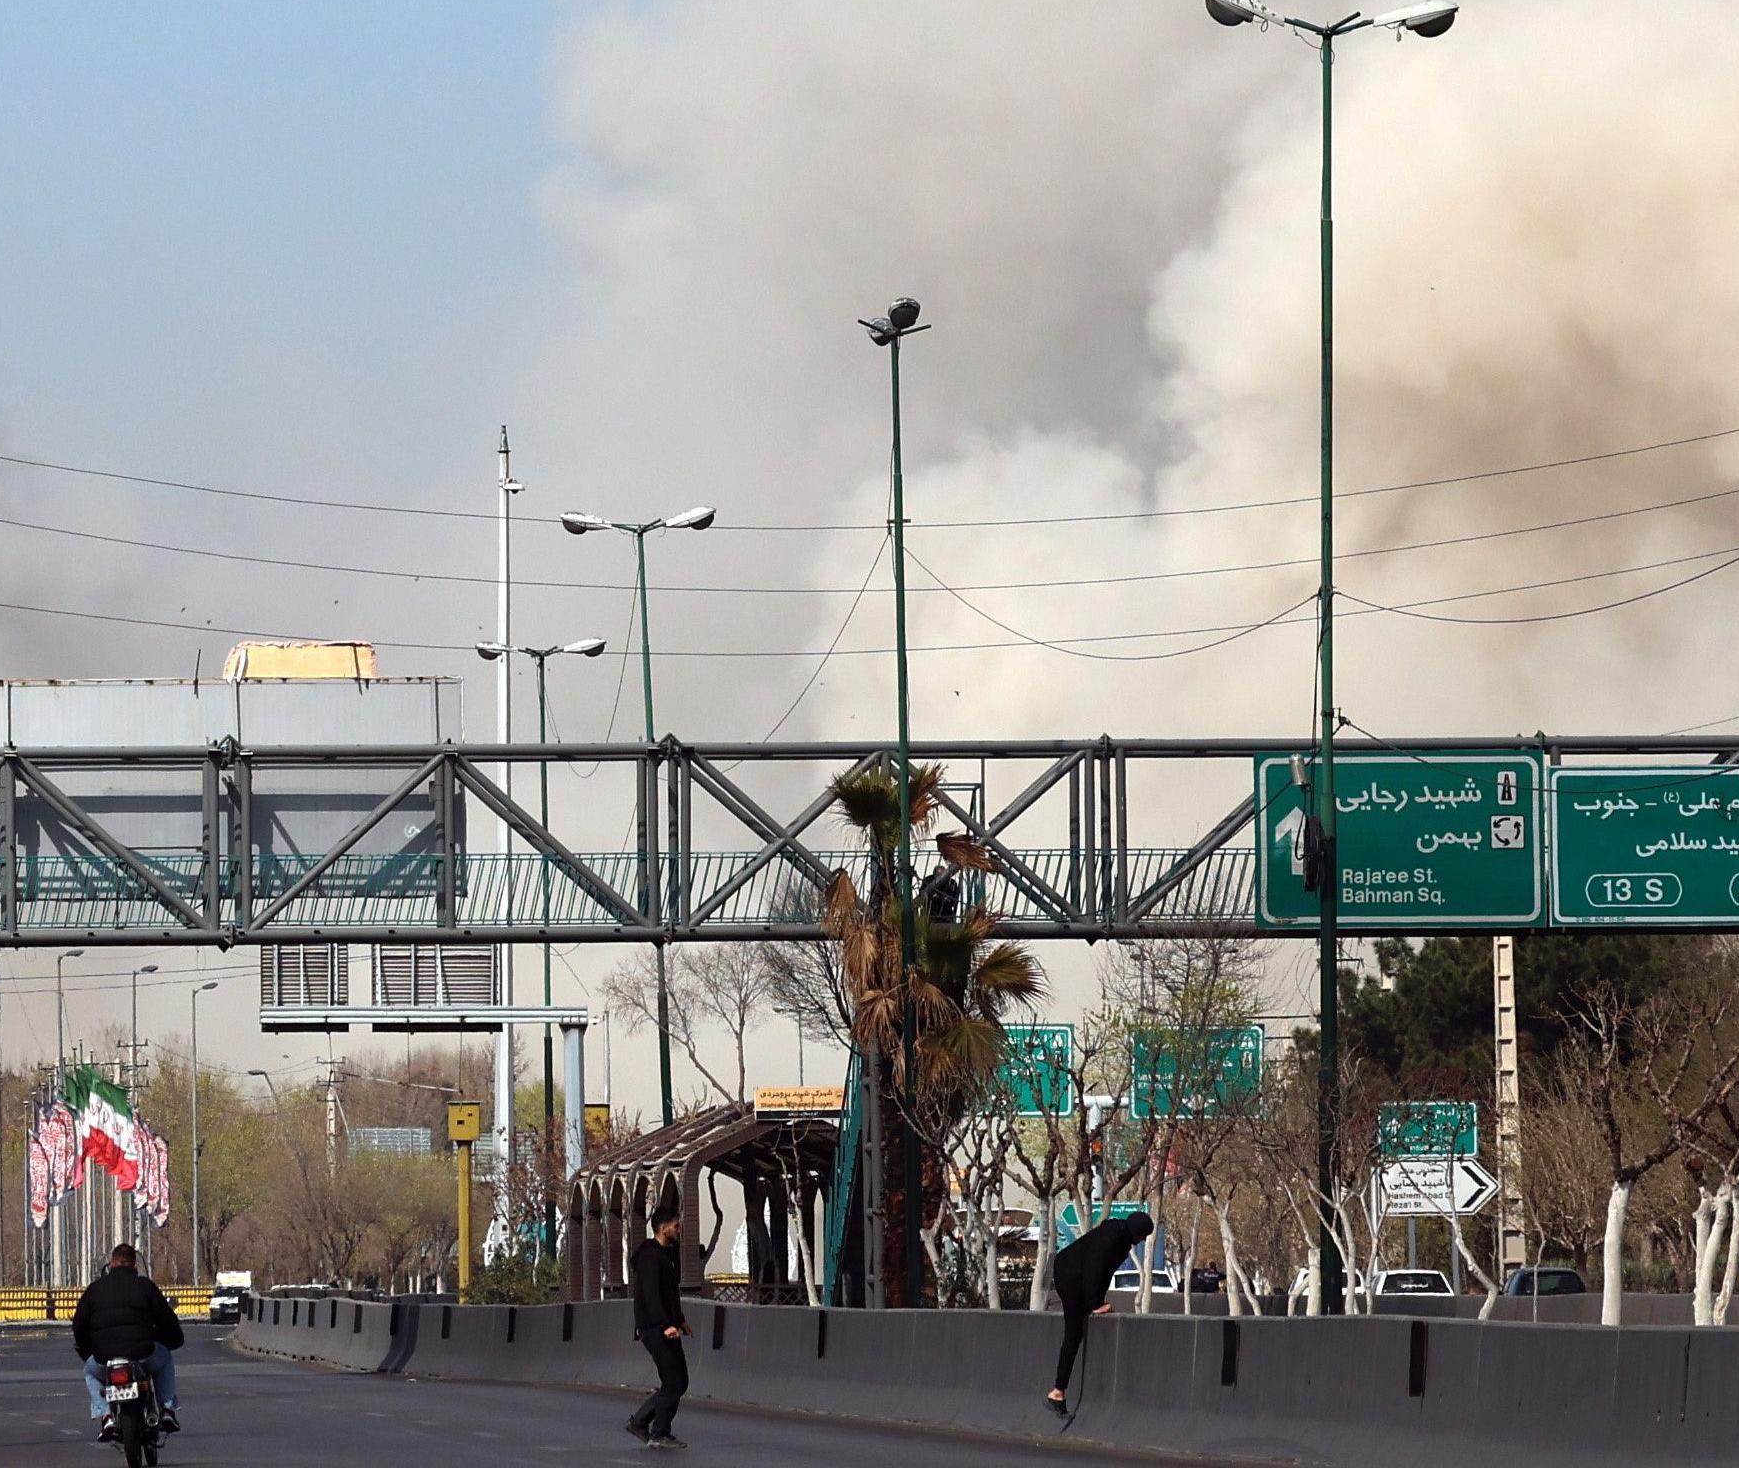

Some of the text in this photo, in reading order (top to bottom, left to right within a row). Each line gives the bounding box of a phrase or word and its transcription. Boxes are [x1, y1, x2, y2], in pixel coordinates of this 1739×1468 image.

[1335, 777, 1482, 813] شهید رجایی
[1573, 793, 1639, 820] جنوب
[1416, 828, 1482, 854] بهمن
[1635, 832, 1708, 858] سلامی
[1342, 868, 1438, 888] Raja'ee St.
[1603, 877, 1663, 902] 13 S
[1342, 887, 1446, 906] Bahman Sq.
